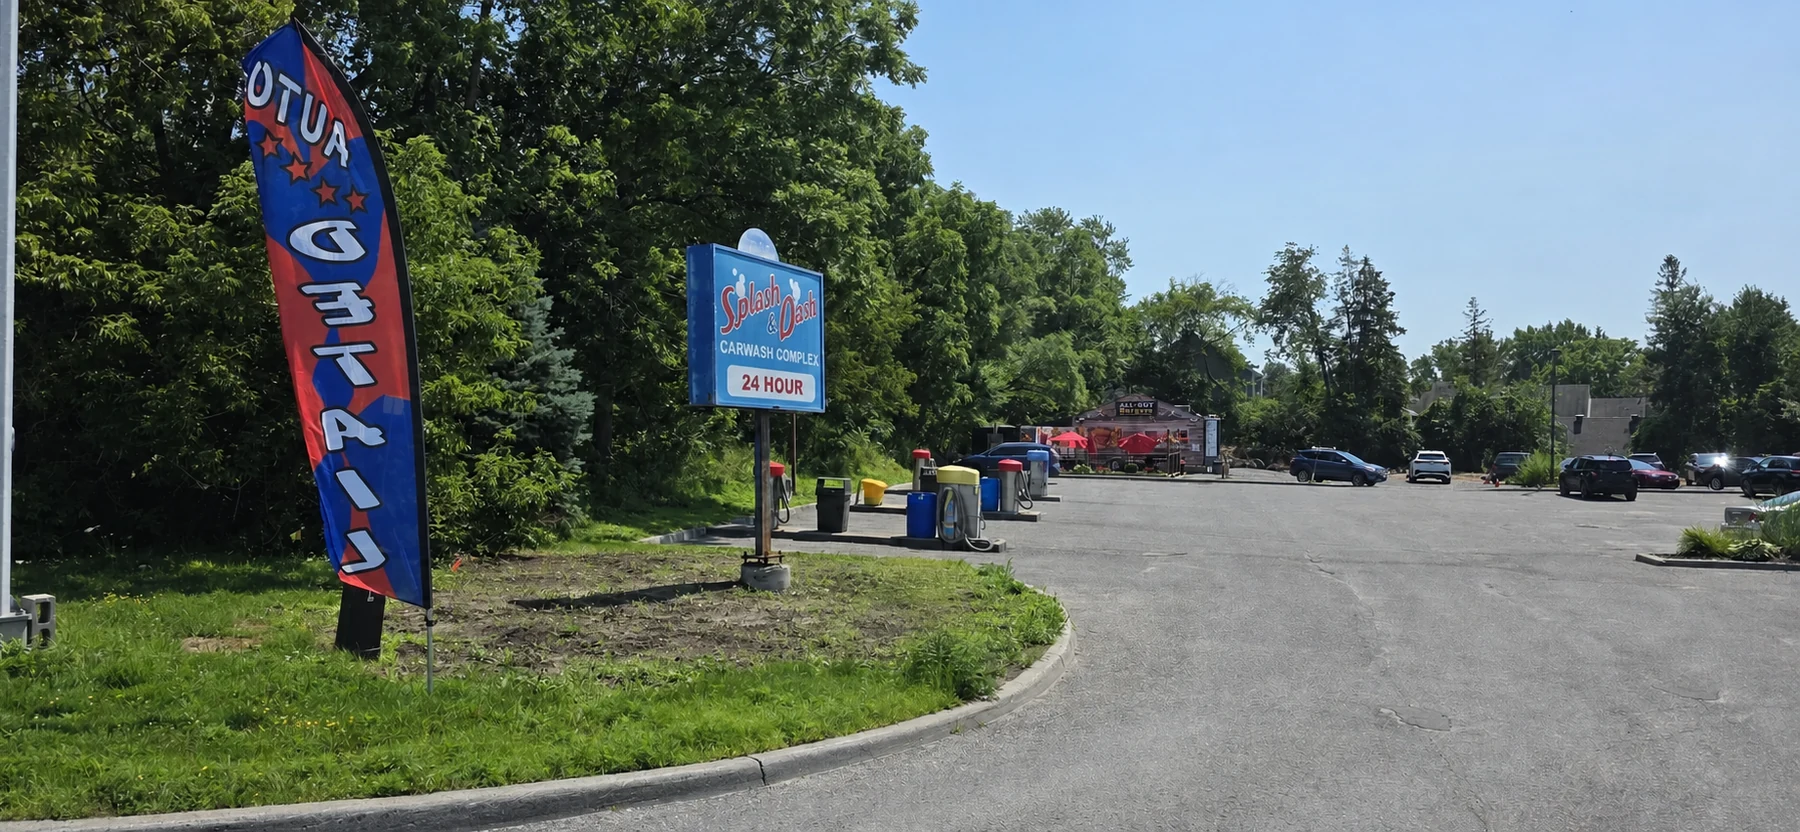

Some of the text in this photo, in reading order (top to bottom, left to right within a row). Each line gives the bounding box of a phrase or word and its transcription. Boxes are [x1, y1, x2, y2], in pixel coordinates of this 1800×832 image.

[720, 273, 781, 335] Splash
[766, 289, 817, 342] & Dash
[720, 339, 820, 367] CARWASH COMPLEX
[742, 374, 804, 395] 24 HOUR
